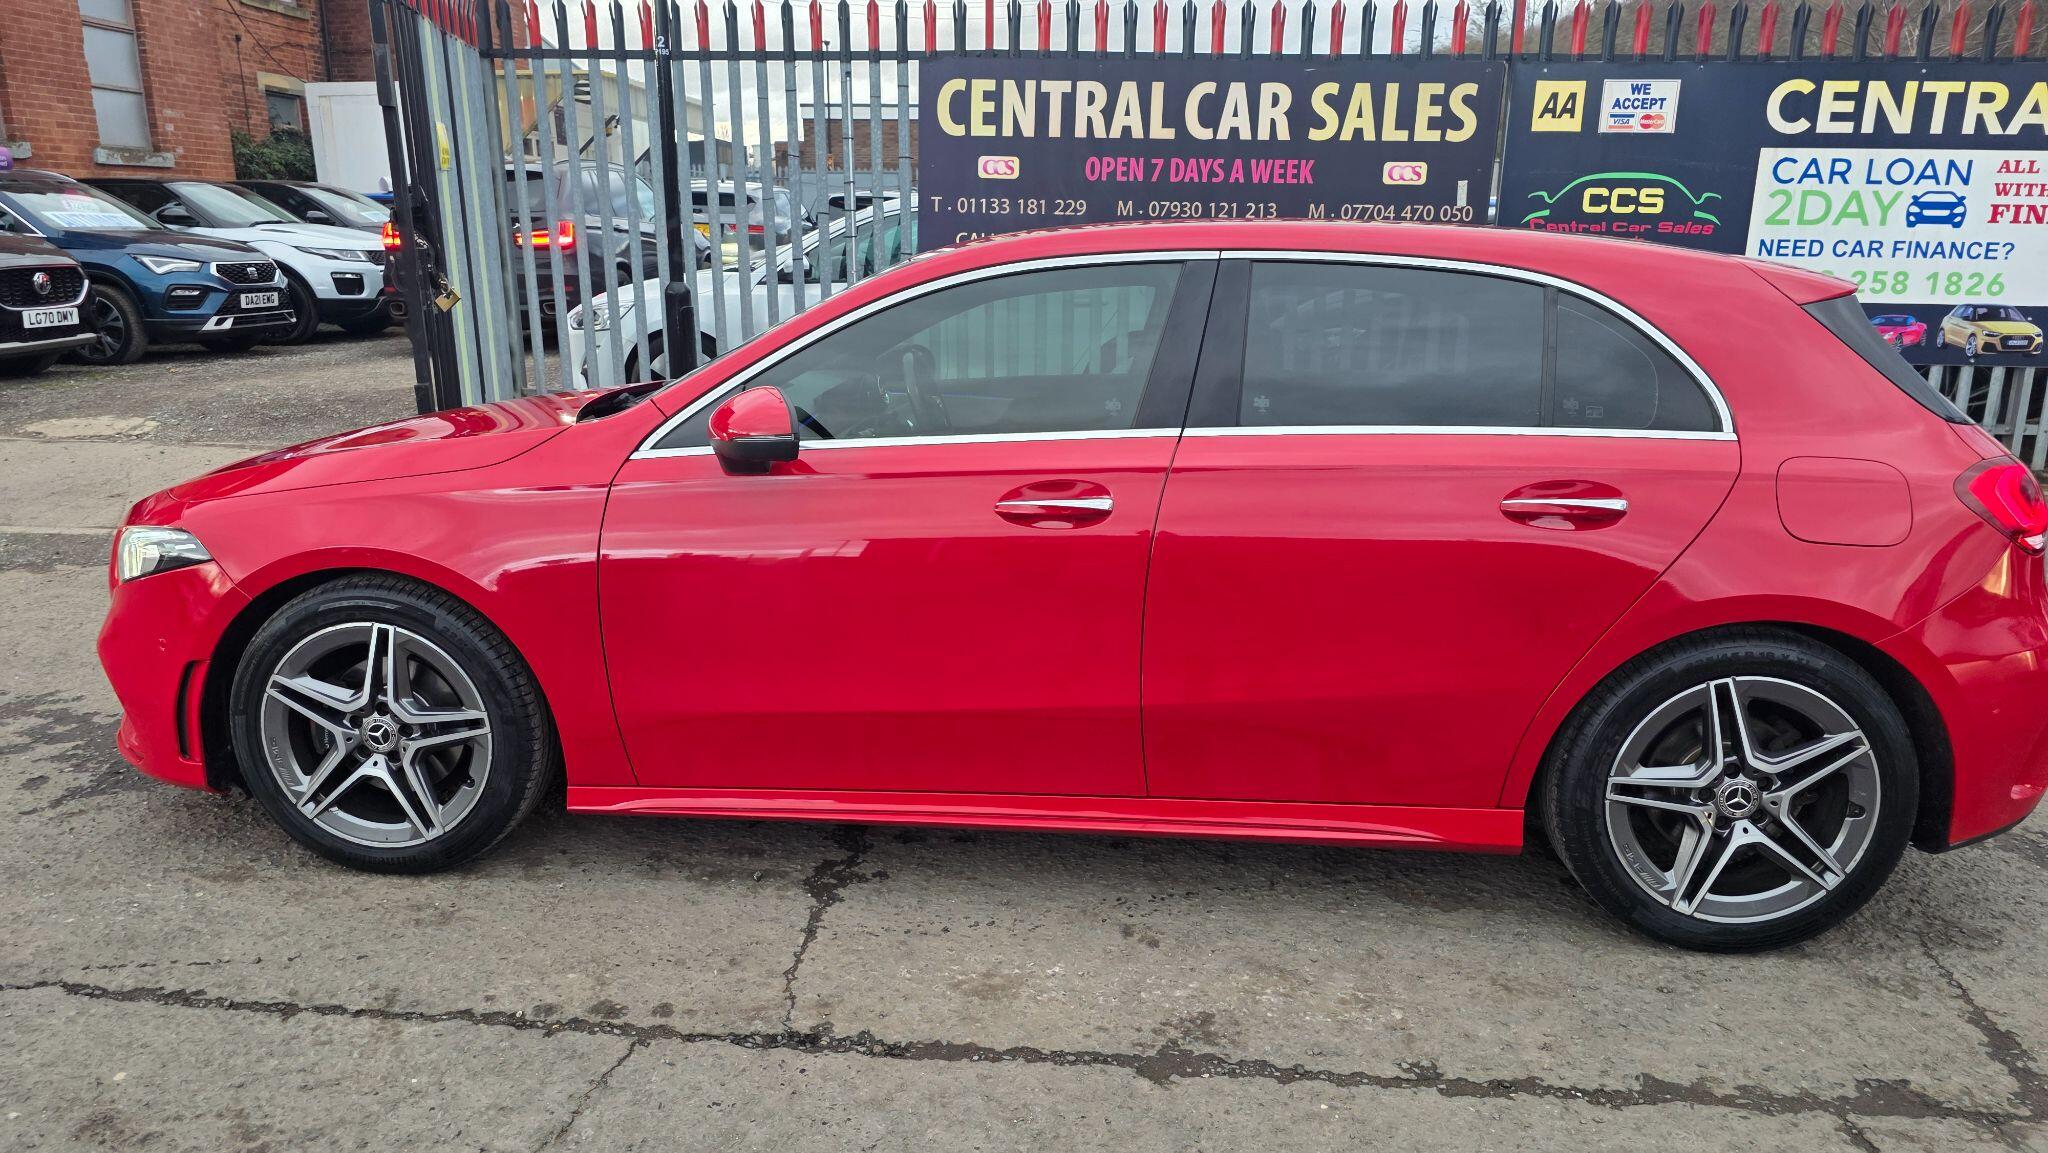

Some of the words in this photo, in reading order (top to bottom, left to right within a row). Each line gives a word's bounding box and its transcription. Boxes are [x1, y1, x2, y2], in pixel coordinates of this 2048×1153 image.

[657, 36, 665, 47] 2
[1631, 83, 1652, 96] WE
[937, 79, 1176, 139] CENTRAL
[1185, 82, 1293, 140] CAR
[1308, 82, 1479, 142] SALES
[1538, 92, 1577, 119] AA
[1612, 97, 1667, 110] ACCEPT
[1766, 79, 2048, 136] CENTRA
[983, 159, 1015, 176] CCS
[1086, 157, 1144, 182] OPEN
[1151, 158, 1164, 182] 7
[1169, 158, 1225, 183] DAYS
[1229, 160, 1244, 183] A
[1250, 159, 1314, 184] WEEK
[1387, 165, 1422, 181] CCS
[1772, 157, 1853, 185] CAR
[1866, 158, 1974, 186] LOAN
[1996, 159, 2040, 174] ALL
[957, 198, 1010, 215] 01133
[1017, 199, 1047, 215] 181
[1054, 200, 1087, 216] 229
[1148, 201, 1202, 218] 07930
[1209, 203, 1238, 218] 121
[1245, 203, 1278, 218] 213
[1340, 204, 1396, 220] 07704
[1401, 205, 1434, 221] 470
[1440, 205, 1474, 222] 050
[1582, 187, 1665, 214] CCS
[1764, 188, 1904, 227] 2DAY
[1529, 218, 1606, 233] Central
[1612, 222, 1652, 232] Car
[1657, 221, 1715, 235] Sales
[1757, 238, 1824, 257] NEED
[1832, 239, 1884, 258] CAR
[1892, 240, 2015, 260] FINANCE?
[1851, 270, 1910, 295] 258
[1926, 271, 2006, 297] 1826
[28, 312, 55, 325] LG70
[56, 310, 74, 323] DMY
